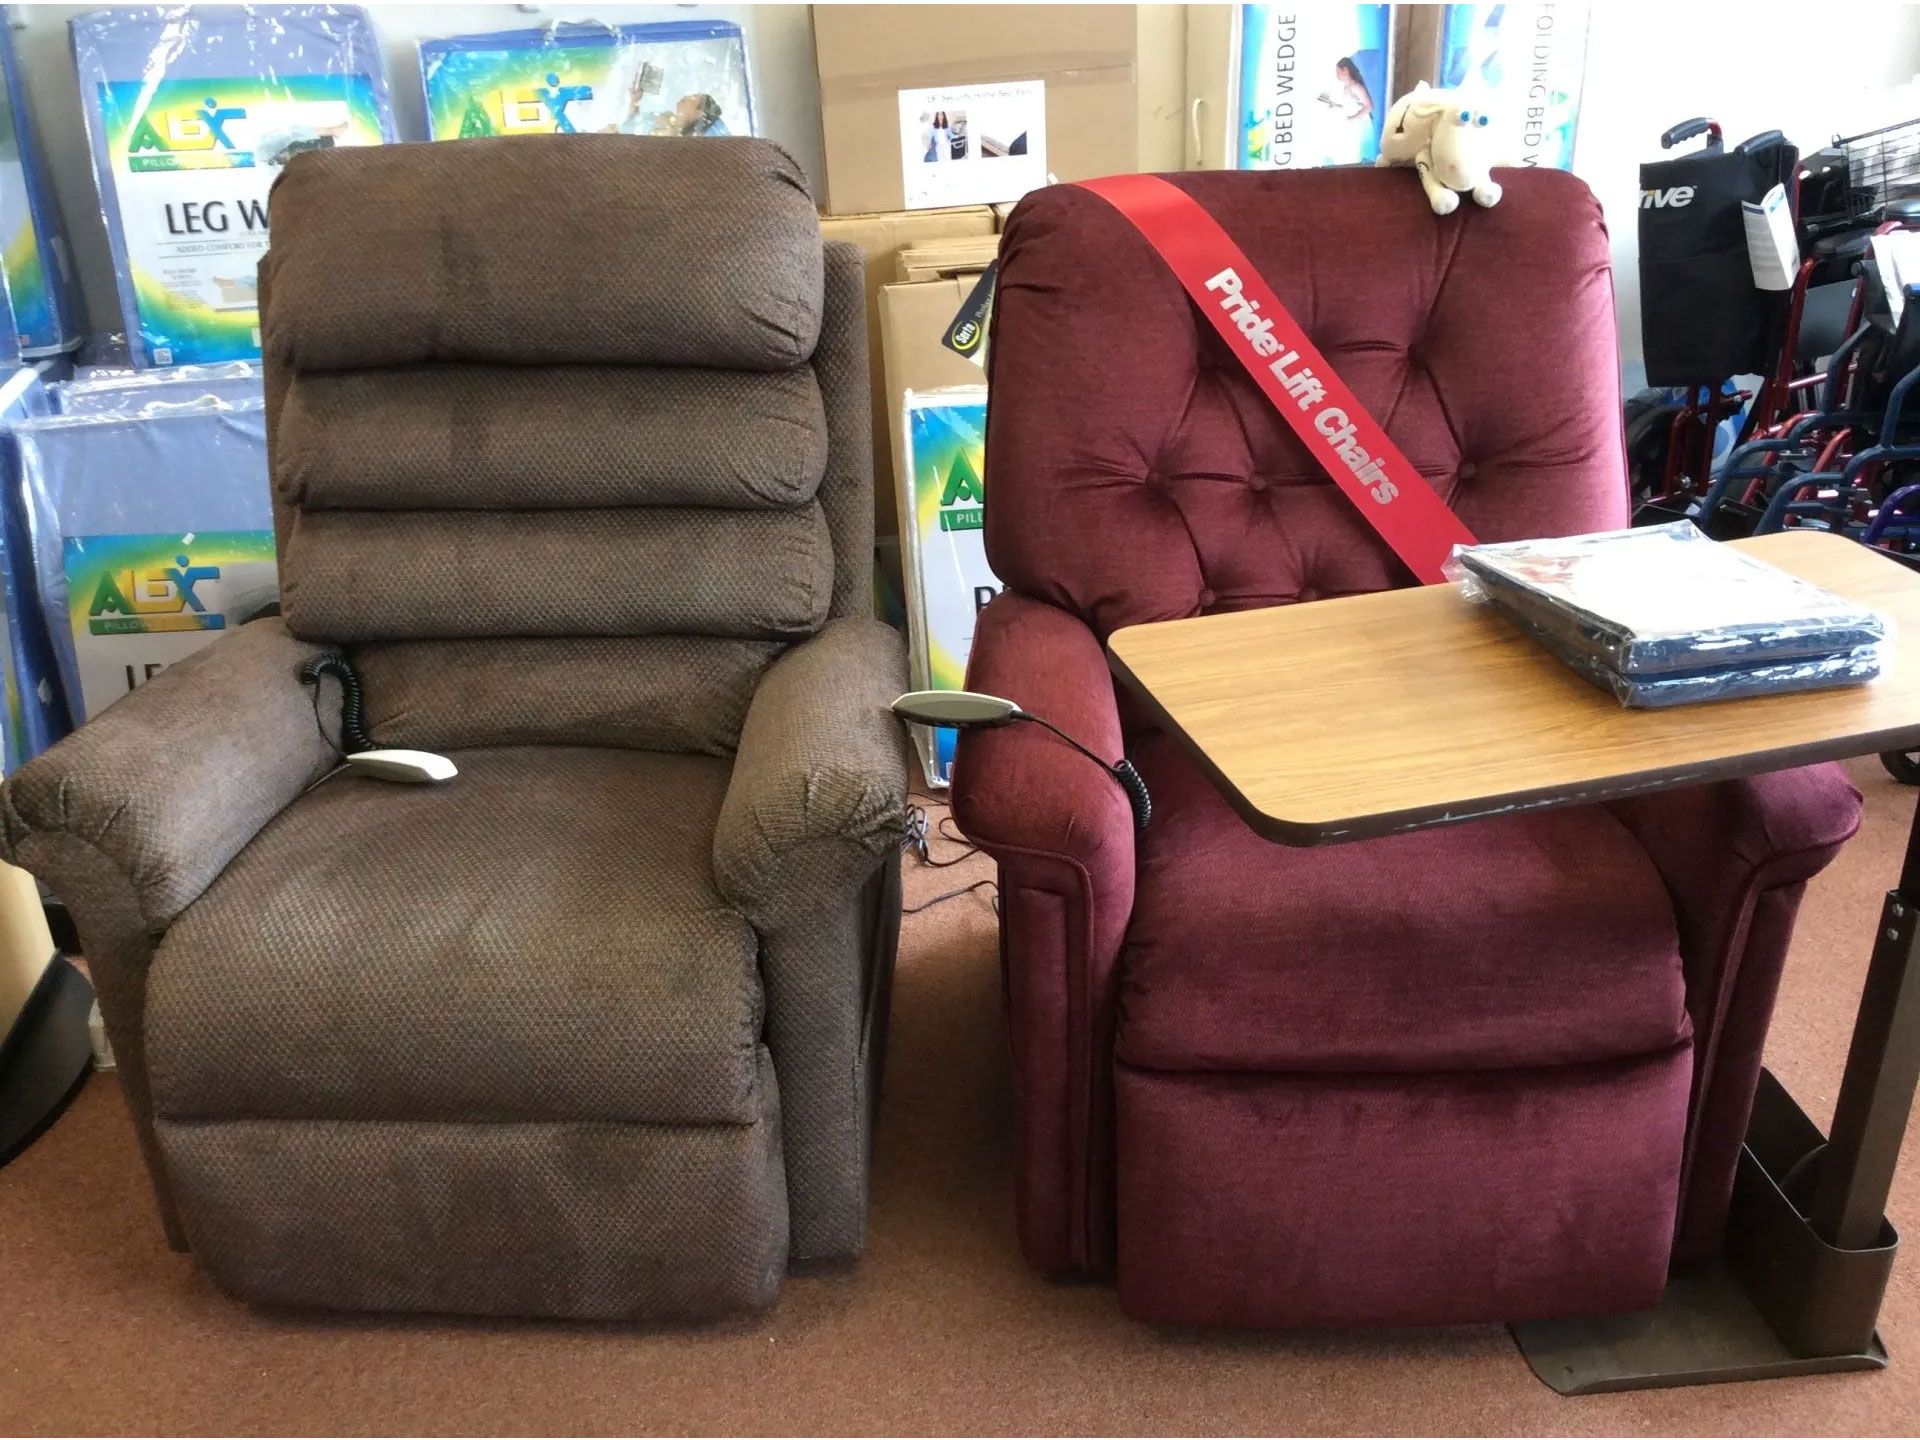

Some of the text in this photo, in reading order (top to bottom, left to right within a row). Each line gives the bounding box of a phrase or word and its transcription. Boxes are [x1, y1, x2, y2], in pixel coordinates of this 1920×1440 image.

[1276, 14, 1297, 95] WEDGE
[1529, 4, 1554, 98] FOLDING
[1275, 102, 1294, 144] BED
[1523, 107, 1544, 147] BED
[164, 199, 269, 235] LEG W
[1638, 185, 1694, 209] rive
[1204, 267, 1399, 505] Pride Lift Chairs
[956, 513, 984, 525] PILL
